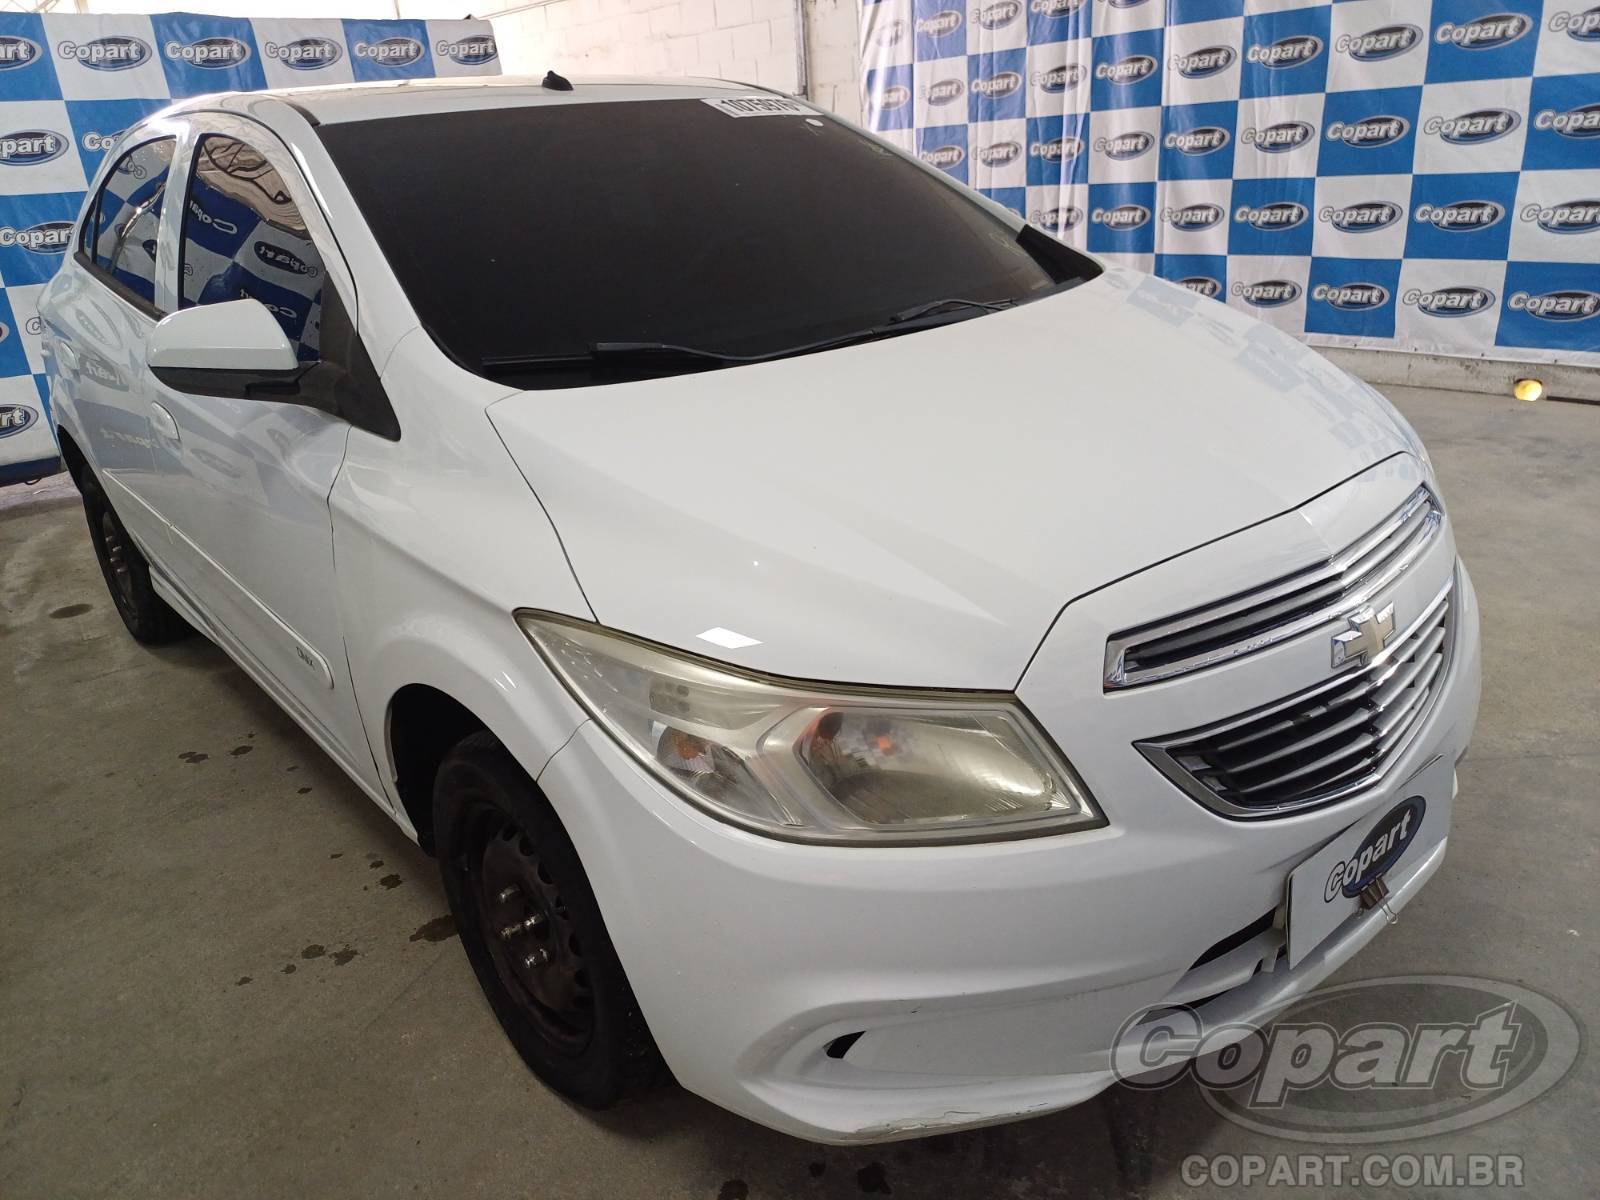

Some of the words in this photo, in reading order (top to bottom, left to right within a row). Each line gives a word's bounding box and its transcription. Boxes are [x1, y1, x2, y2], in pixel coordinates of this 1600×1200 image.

[1435, 15, 1521, 46] Copart
[1549, 11, 1600, 35] Cop
[58, 39, 141, 64] Copart
[165, 40, 242, 64] Copart
[265, 40, 332, 63] Copart
[354, 41, 417, 62] Copart
[436, 39, 495, 60] Copart
[1247, 38, 1316, 64] Copart
[1336, 28, 1414, 56] Copart
[1096, 58, 1151, 81] Copart
[1168, 50, 1230, 73] Copart
[971, 76, 1017, 95] Copart
[1326, 120, 1401, 144] Copart
[1424, 112, 1510, 139] Copart
[1535, 108, 1600, 135] Copa
[1094, 135, 1149, 155] Copart
[1164, 131, 1221, 151] Copart
[1241, 125, 1306, 145] Copart
[0, 135, 56, 160] part
[1091, 206, 1145, 225] Copart
[1160, 207, 1218, 226] Copart
[1235, 205, 1302, 226] Copart
[1319, 205, 1393, 227] Copart
[1415, 204, 1495, 227] Copart
[1231, 282, 1294, 301] Copart
[1312, 284, 1382, 305] Copart
[1403, 288, 1486, 310] Copart
[1508, 291, 1599, 315] Copart
[1324, 809, 1411, 903] Copart
